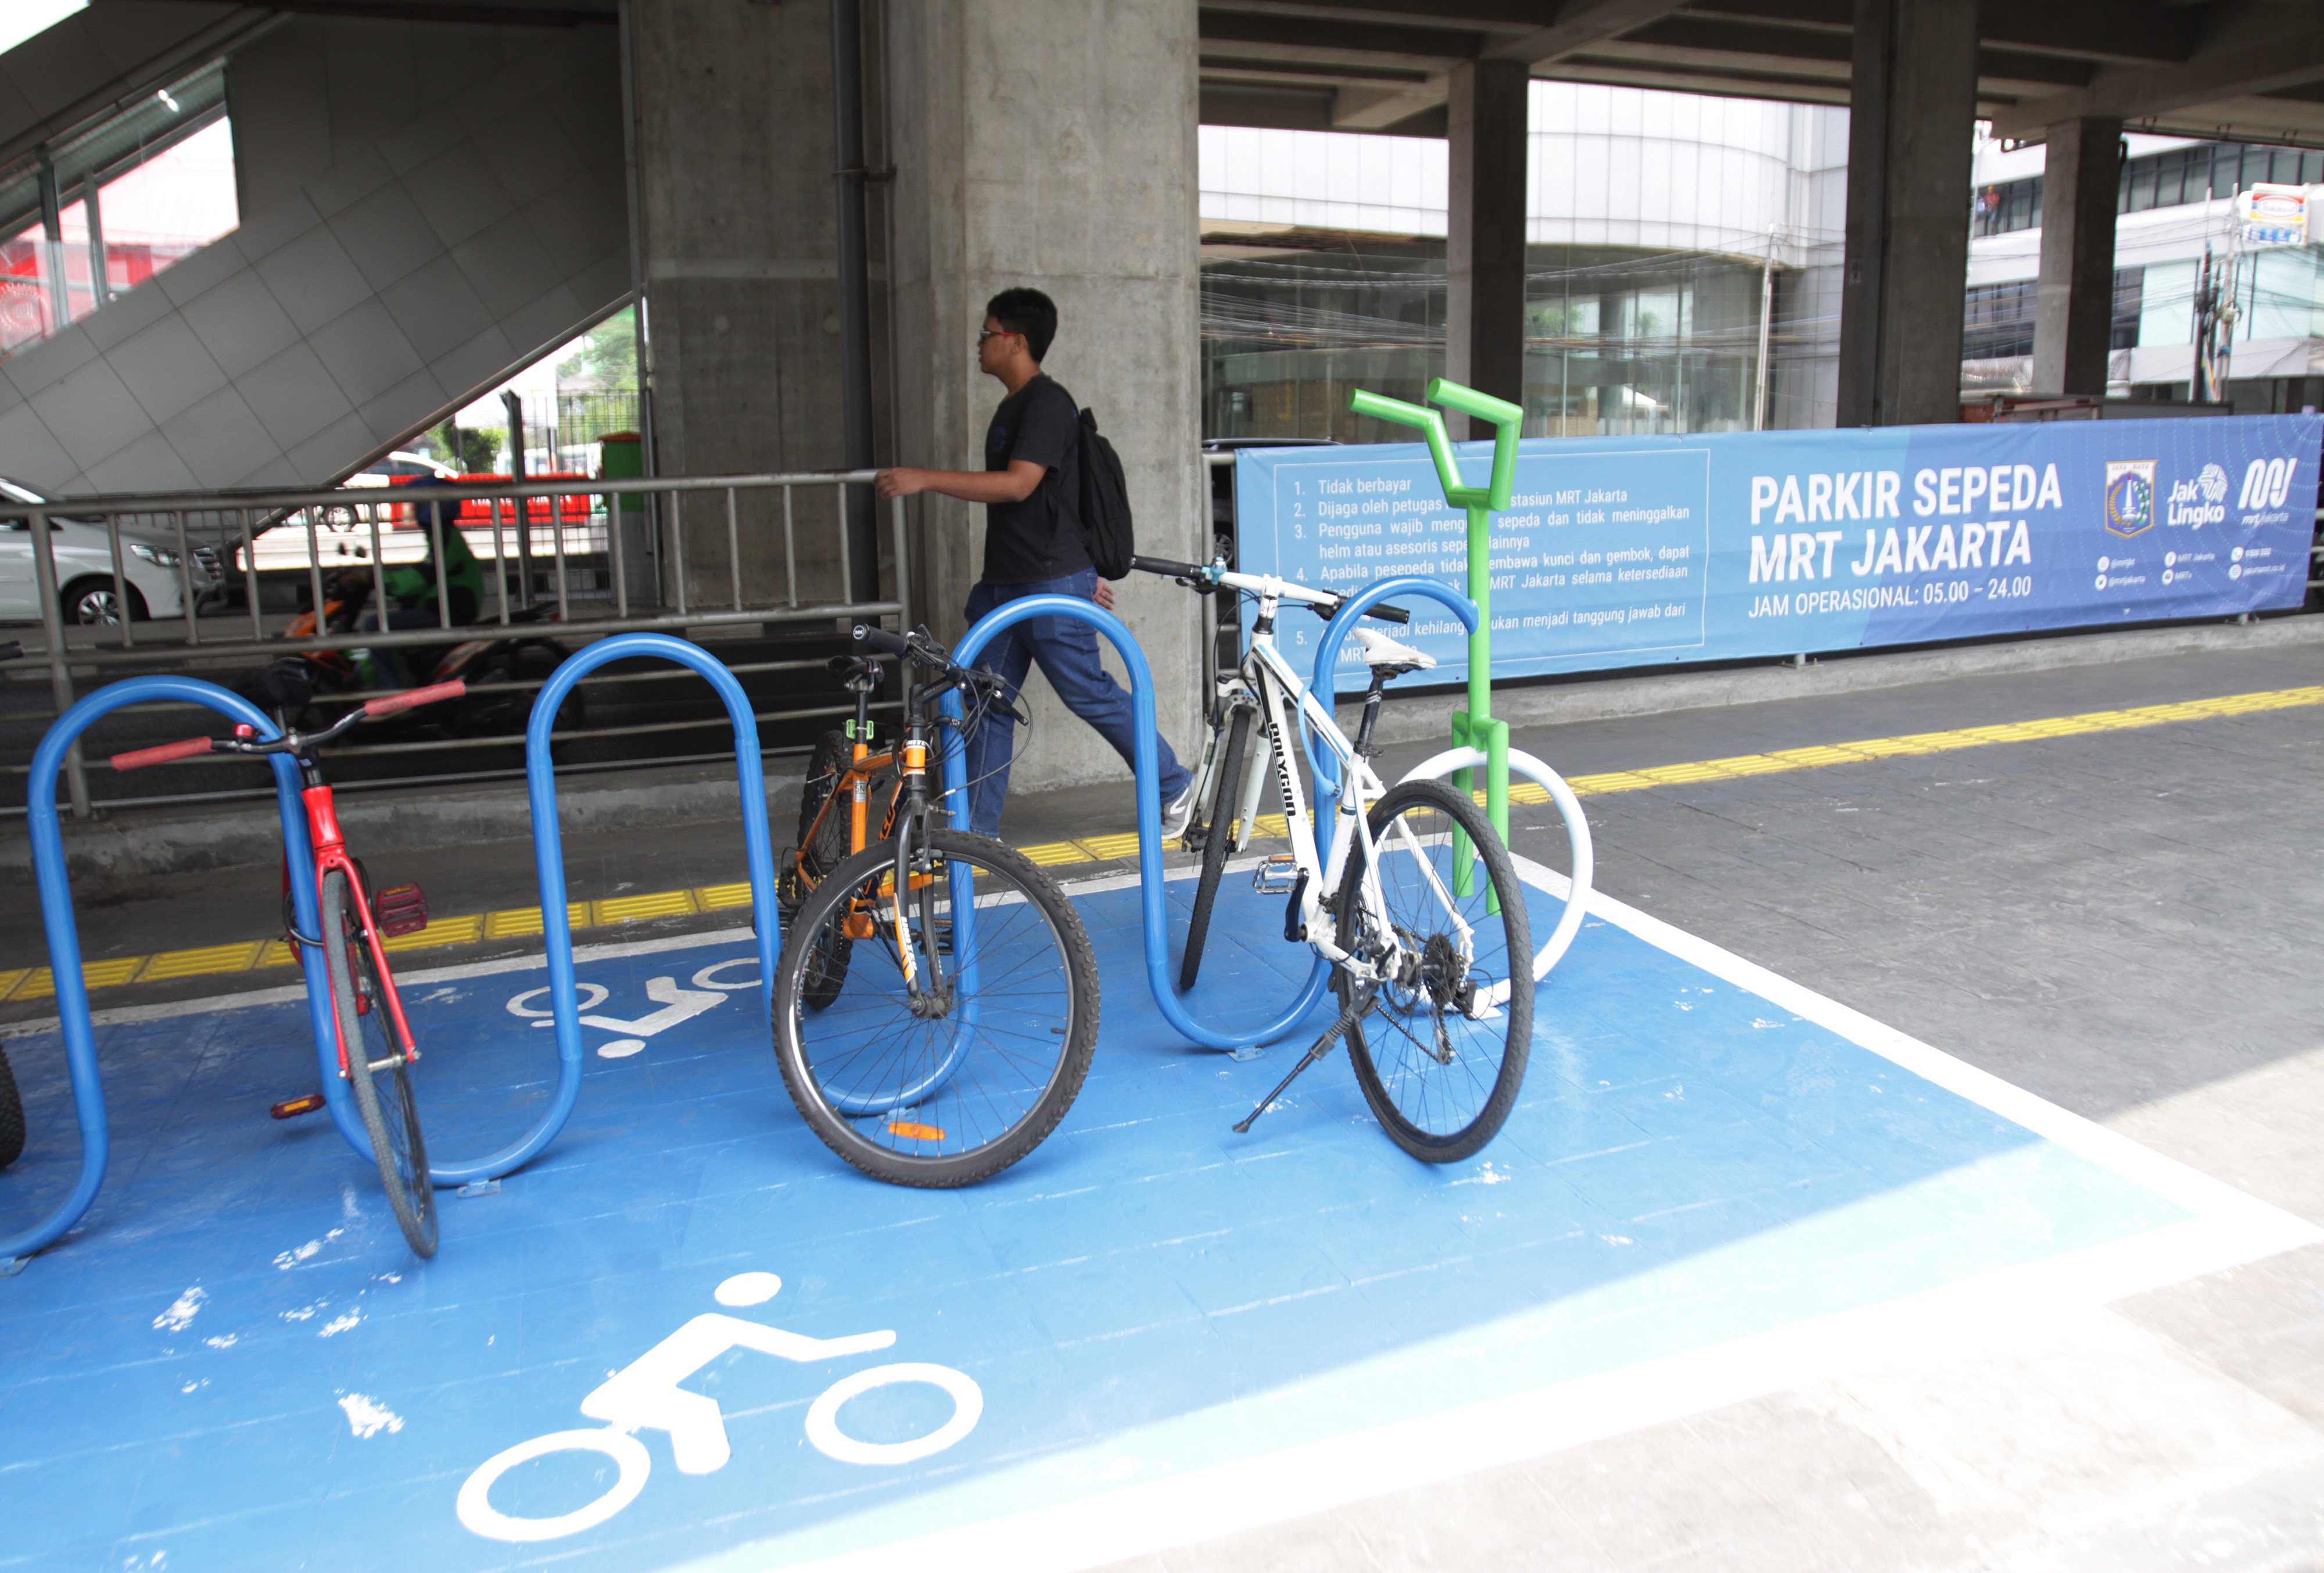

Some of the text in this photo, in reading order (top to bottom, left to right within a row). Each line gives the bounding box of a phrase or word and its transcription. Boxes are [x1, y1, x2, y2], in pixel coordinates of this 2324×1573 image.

[1294, 477, 1412, 495] 1. Tidak berbayar
[1751, 463, 2063, 525] PARKIR SEPEDA
[2168, 479, 2199, 503] Jak
[1293, 502, 1306, 517] 2.
[1318, 501, 1358, 518] Dijaga
[1362, 498, 1389, 514] oleh
[1392, 499, 1442, 515] petugas
[1511, 492, 1552, 507] stasiun
[1556, 490, 1581, 505] MRT
[1584, 488, 1627, 504] Jakarta
[2167, 503, 2225, 531] Lingko
[1294, 524, 1306, 539] 3.
[1318, 522, 1382, 539] Pengguna
[1390, 518, 1423, 536] wajib
[1498, 513, 1540, 531] sepeda
[1547, 511, 1569, 526] dan
[1576, 510, 1605, 524] tidak
[1612, 506, 1690, 525] meninggalkan
[1319, 543, 1351, 558] helm
[1355, 543, 1382, 557] atau
[1386, 539, 1438, 554] asesoris
[1489, 535, 1530, 551] lainnya
[1749, 519, 2032, 583] MRT JAKARTA
[1296, 567, 1308, 581] 4.
[1321, 564, 1368, 582] Apabila
[1489, 554, 1538, 570] embawa
[1543, 552, 1575, 567] kunci
[1580, 550, 1601, 564] dan
[1606, 547, 1654, 565] gembok,
[1659, 546, 1690, 562] dapat
[1490, 565, 1688, 590] MRT Jakarta selama ketersediaan
[1748, 594, 1789, 618] JAM
[1795, 585, 1919, 615] OPERASIONAL:
[1923, 581, 1968, 604] 05.00
[1988, 575, 2032, 600] 24.00
[1296, 630, 1307, 645] 5.
[1491, 615, 1519, 630] ukan
[1523, 611, 1569, 630] menjadi
[1573, 608, 1625, 626] tanggung
[1629, 605, 1660, 623] jawab
[1665, 603, 1686, 617] dari
[1269, 722, 1296, 817] POLYGON
